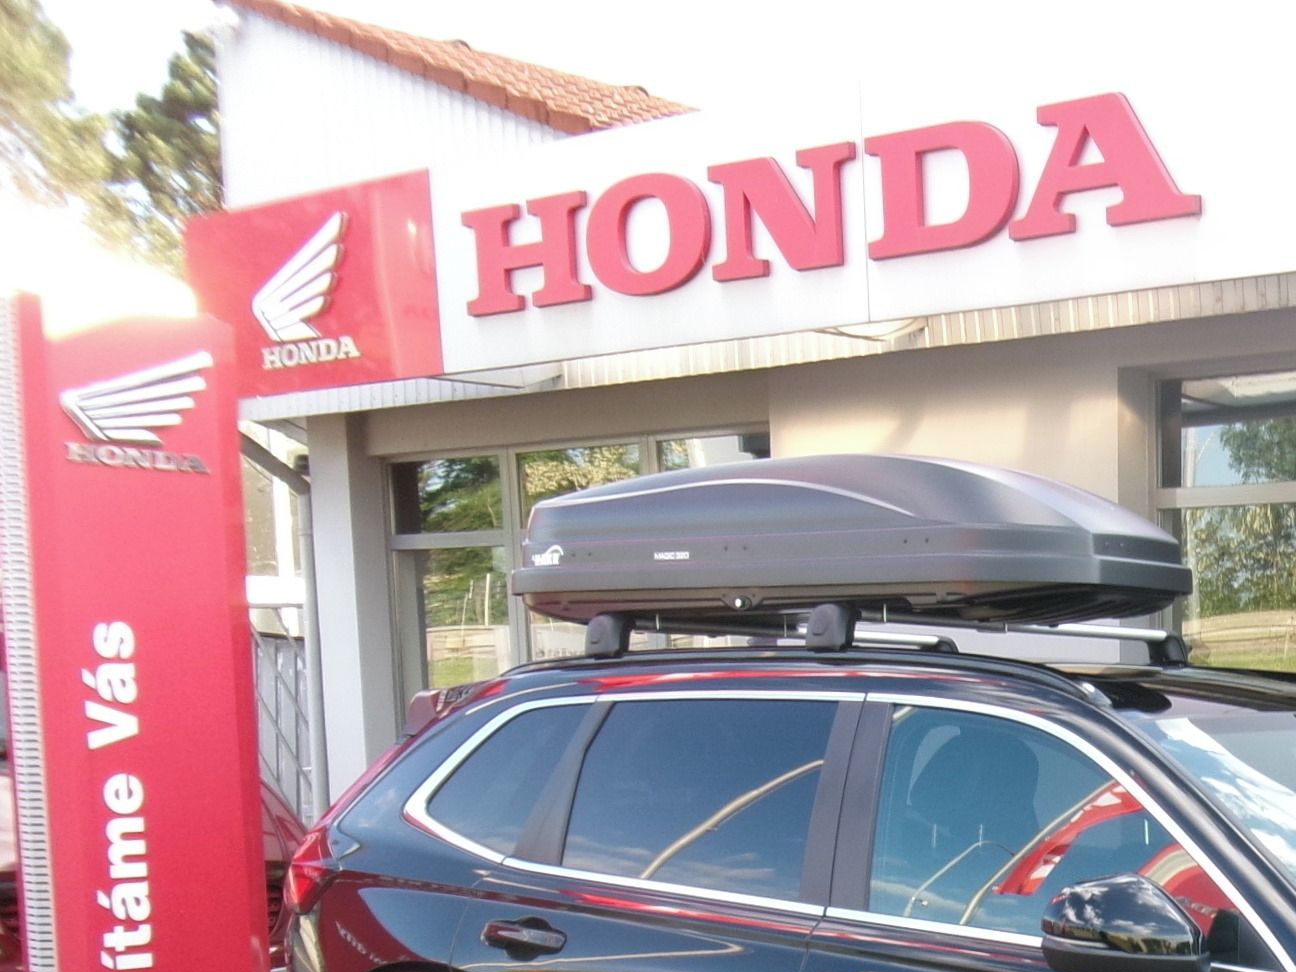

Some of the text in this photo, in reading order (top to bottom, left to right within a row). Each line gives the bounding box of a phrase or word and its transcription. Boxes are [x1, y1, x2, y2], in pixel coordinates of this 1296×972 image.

[462, 91, 1202, 317] HONDA
[262, 336, 361, 370] HONDA
[65, 442, 210, 475] HONDA
[81, 620, 140, 750] Vás
